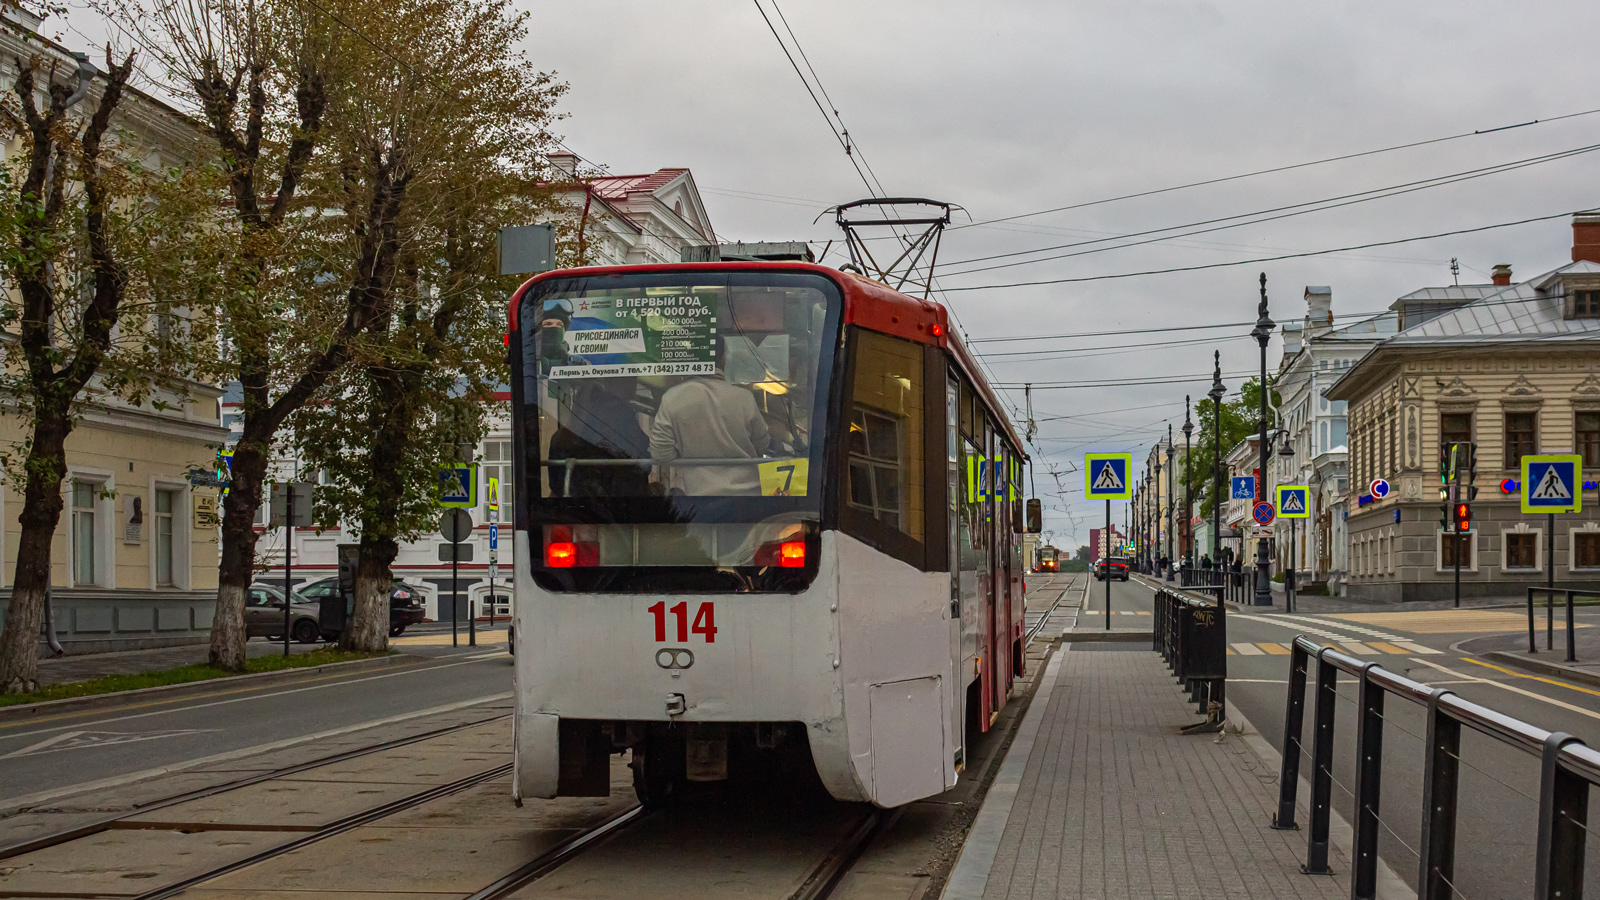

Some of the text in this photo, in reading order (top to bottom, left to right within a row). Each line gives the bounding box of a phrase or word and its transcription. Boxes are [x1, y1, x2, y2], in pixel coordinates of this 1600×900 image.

[616, 294, 701, 307] В ПЕРВЫЙ ГОД
[631, 309, 637, 317] 4
[641, 308, 661, 316] 520
[664, 307, 685, 316] 000
[688, 306, 712, 317] руб.
[575, 329, 639, 341] ПРИСОЕДИНЯЙСЯ
[574, 344, 608, 353] К СВОИМ!
[654, 365, 674, 374] (342)
[776, 465, 795, 491] 7
[492, 528, 497, 547] P
[648, 601, 718, 643] 114
